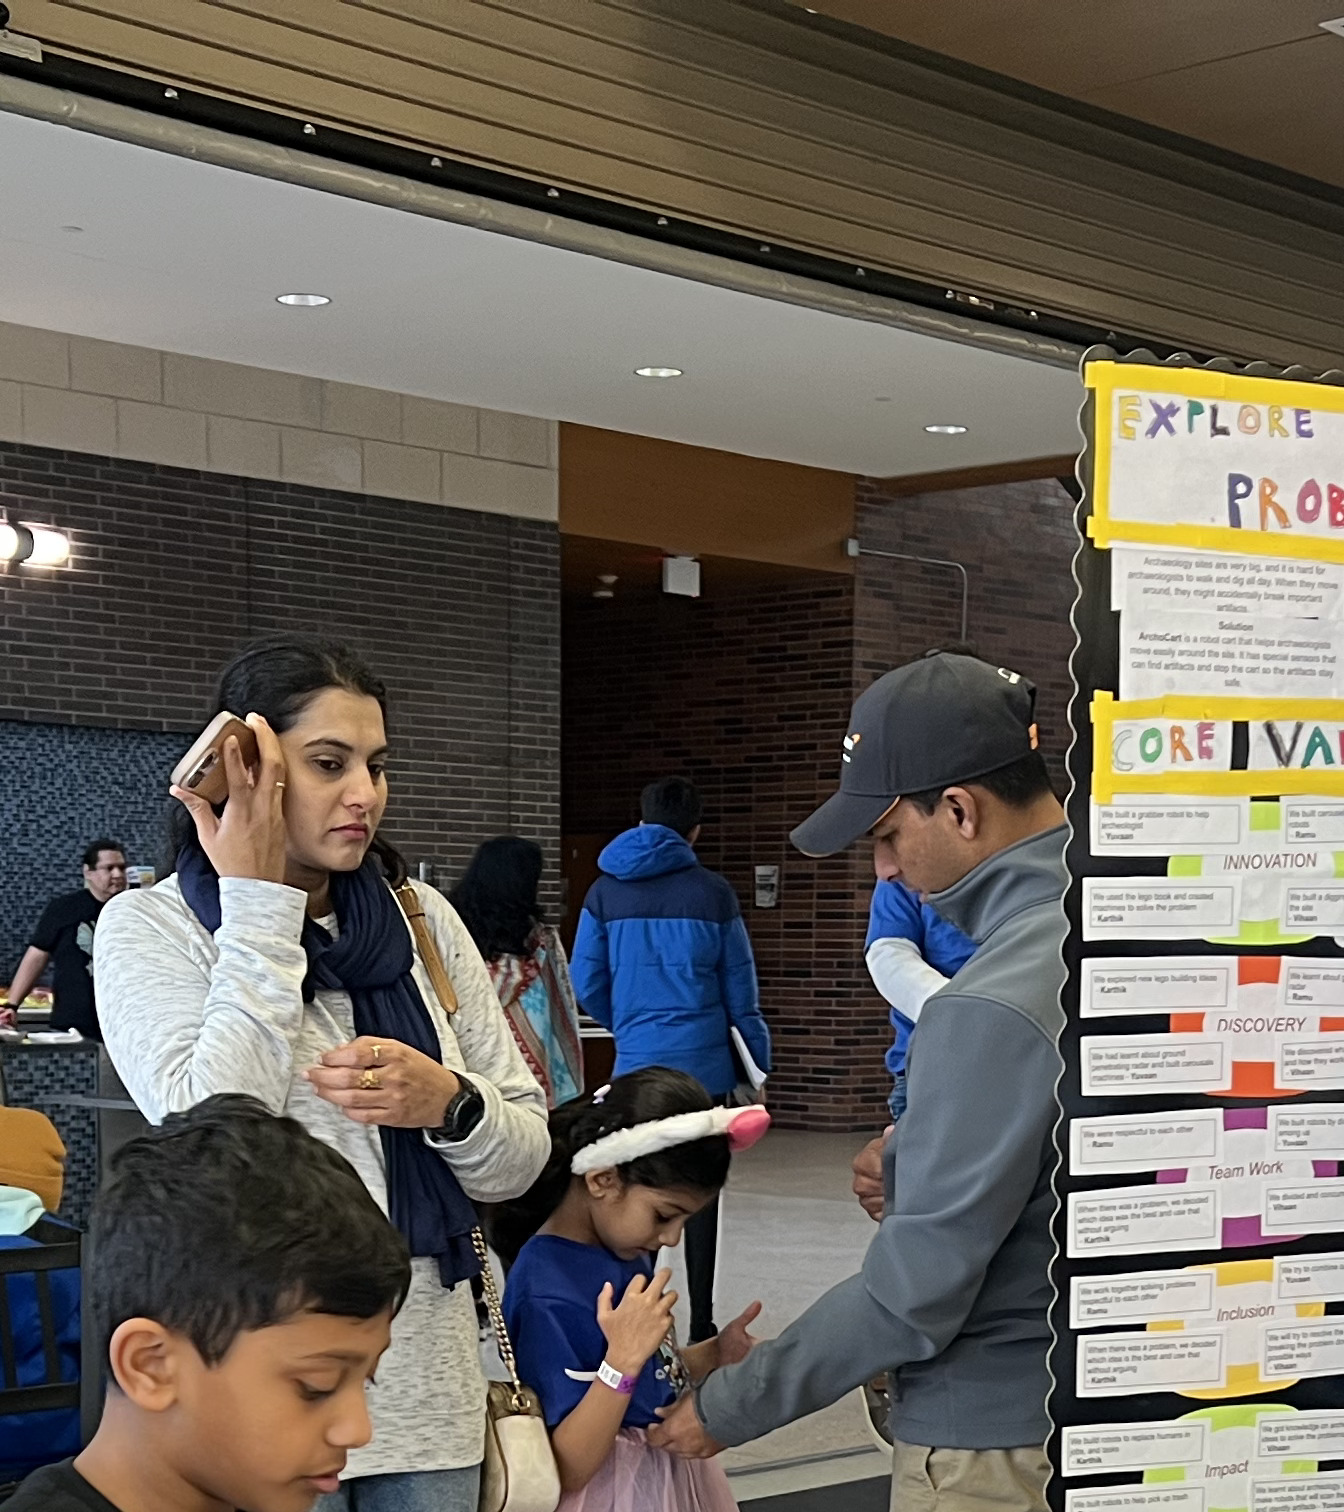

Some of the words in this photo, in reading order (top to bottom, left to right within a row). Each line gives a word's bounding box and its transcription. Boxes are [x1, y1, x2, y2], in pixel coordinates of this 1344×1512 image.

[1118, 395, 1314, 440] EXPLORE
[1112, 721, 1216, 772] CORE
[1223, 853, 1318, 871] INNOVATION
[1217, 1017, 1308, 1032] DISCOVERY
[1208, 1164, 1245, 1180] Team
[1248, 1160, 1284, 1177] Work
[1216, 1304, 1275, 1322] Inclusion
[1205, 1460, 1249, 1479] Impact
